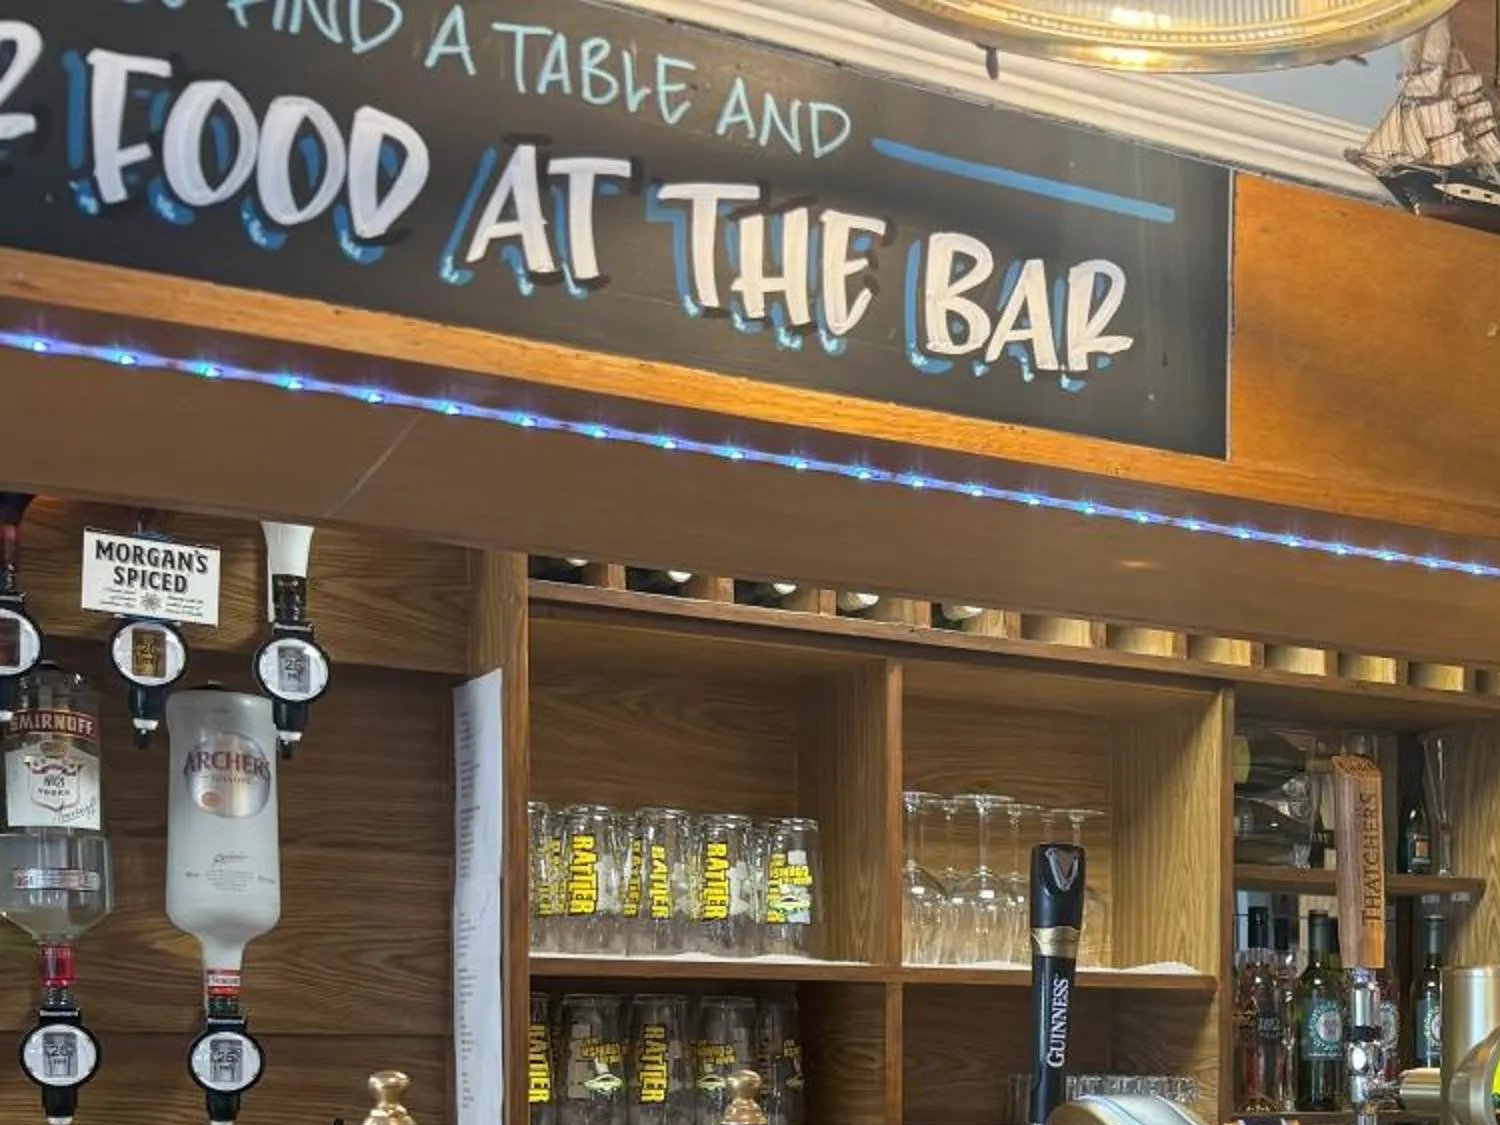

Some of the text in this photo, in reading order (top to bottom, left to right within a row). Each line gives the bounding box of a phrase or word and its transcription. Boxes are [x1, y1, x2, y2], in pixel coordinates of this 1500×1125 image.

[426, 4, 477, 76] A
[491, 21, 697, 125] TABLE
[716, 76, 852, 159] AND
[86, 47, 430, 240] FOOD
[464, 144, 632, 281] AT
[656, 182, 888, 337] THE
[924, 231, 1134, 373] BAR
[94, 539, 209, 575] MORGAN'S
[113, 565, 189, 594] SPICED
[10, 710, 95, 737] SMIRNOFF
[183, 750, 272, 779] ARCHERS
[700, 842, 730, 920] RATTLER
[1360, 791, 1383, 926] THATCHERS
[1046, 977, 1070, 1068] GUINNESS
